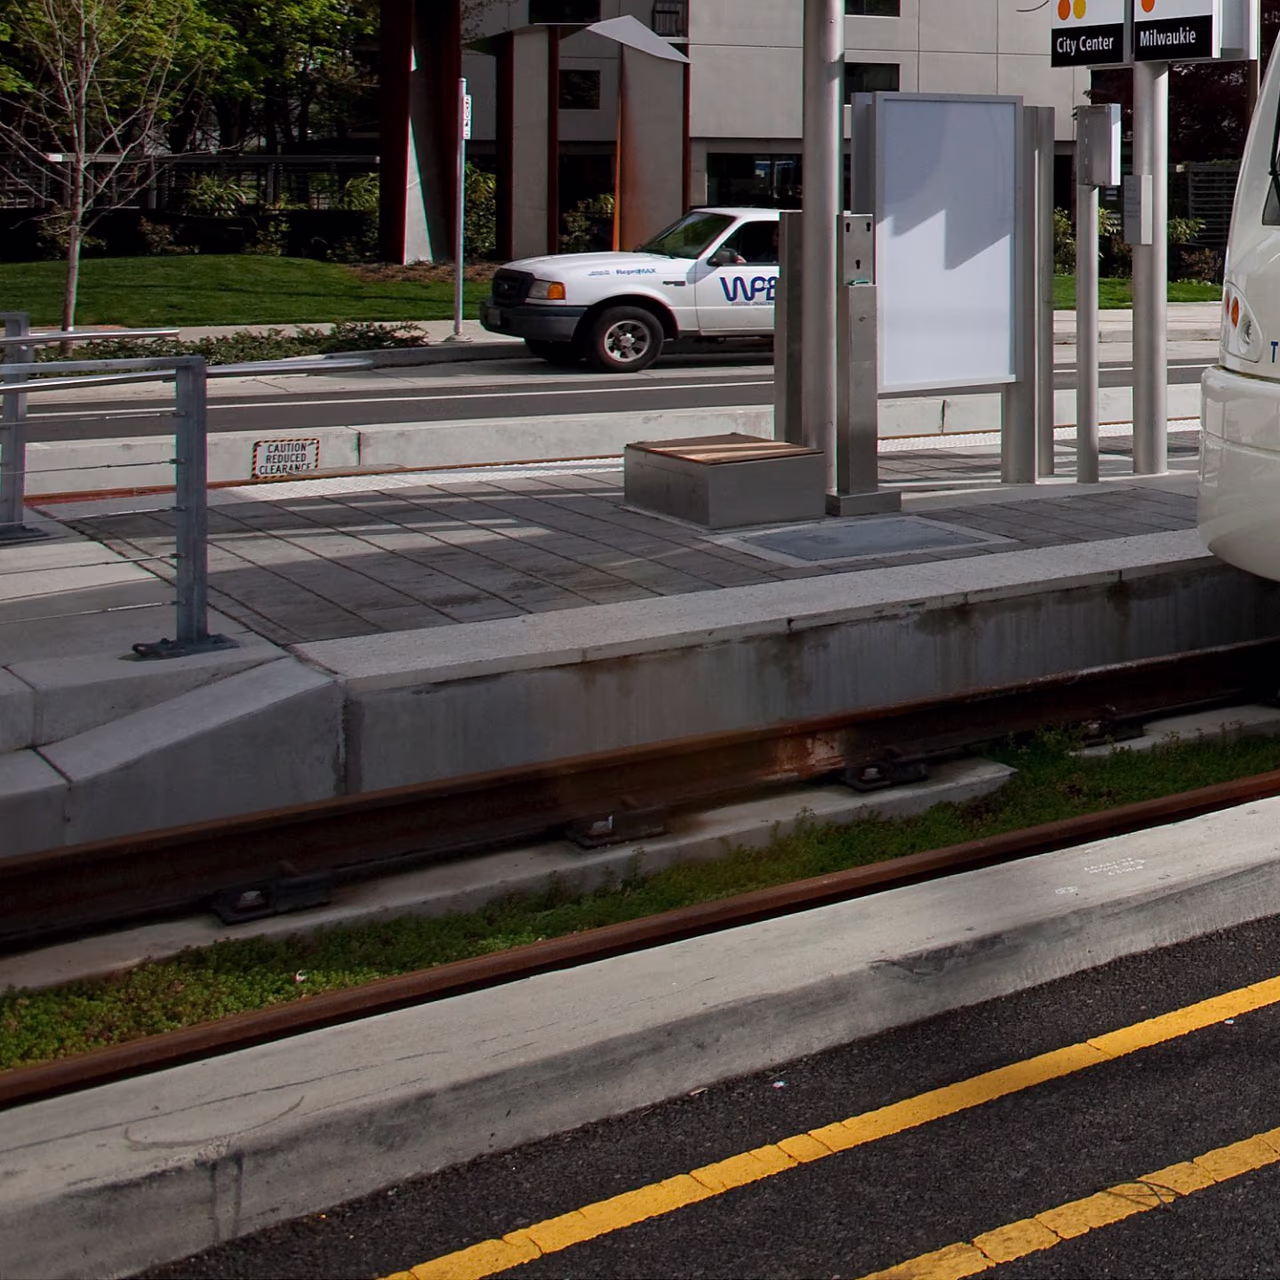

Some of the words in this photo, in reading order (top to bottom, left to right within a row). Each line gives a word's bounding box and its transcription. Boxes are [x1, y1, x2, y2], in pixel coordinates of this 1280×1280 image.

[1139, 27, 1197, 47] Milwaukie
[1056, 37, 1077, 56] City
[1079, 36, 1114, 52] Center
[268, 443, 307, 453] CAUTION
[265, 453, 307, 464] REDUCED
